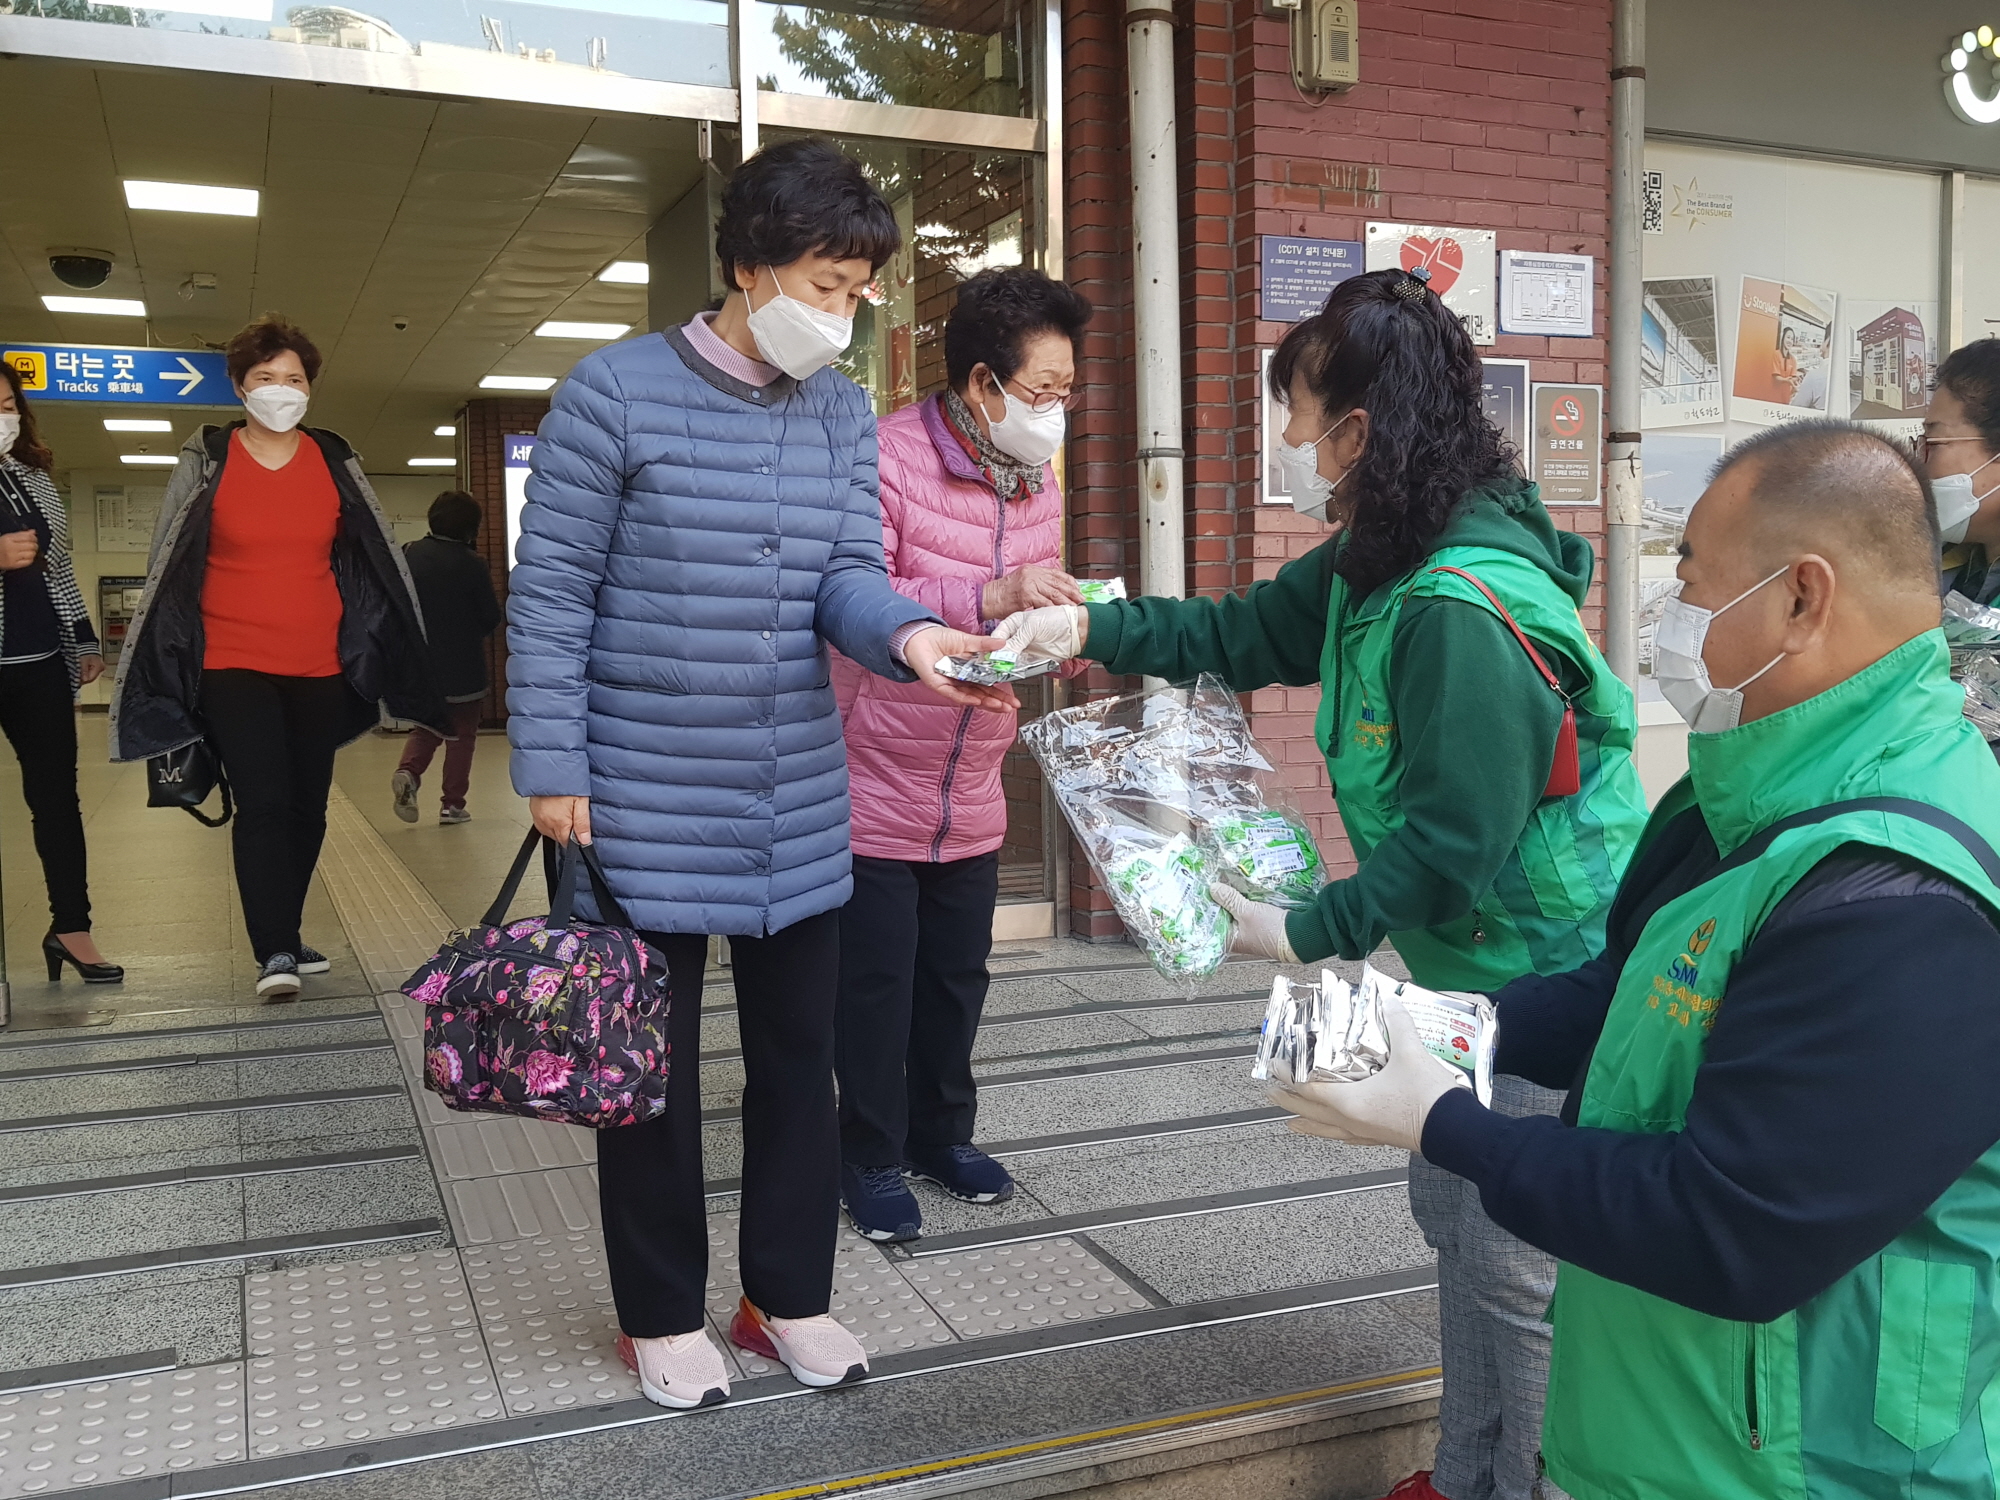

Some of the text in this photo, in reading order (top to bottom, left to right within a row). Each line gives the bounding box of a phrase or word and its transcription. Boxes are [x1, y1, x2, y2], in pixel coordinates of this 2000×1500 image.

[1710, 201, 1725, 209] Brand
[1697, 208, 1732, 218] CONSUMER
[1305, 246, 1319, 256] 설치
[55, 352, 134, 380] 타는 곳
[56, 379, 99, 393] Tracks
[1550, 439, 1584, 450] 금연건물
[158, 767, 183, 783] M
